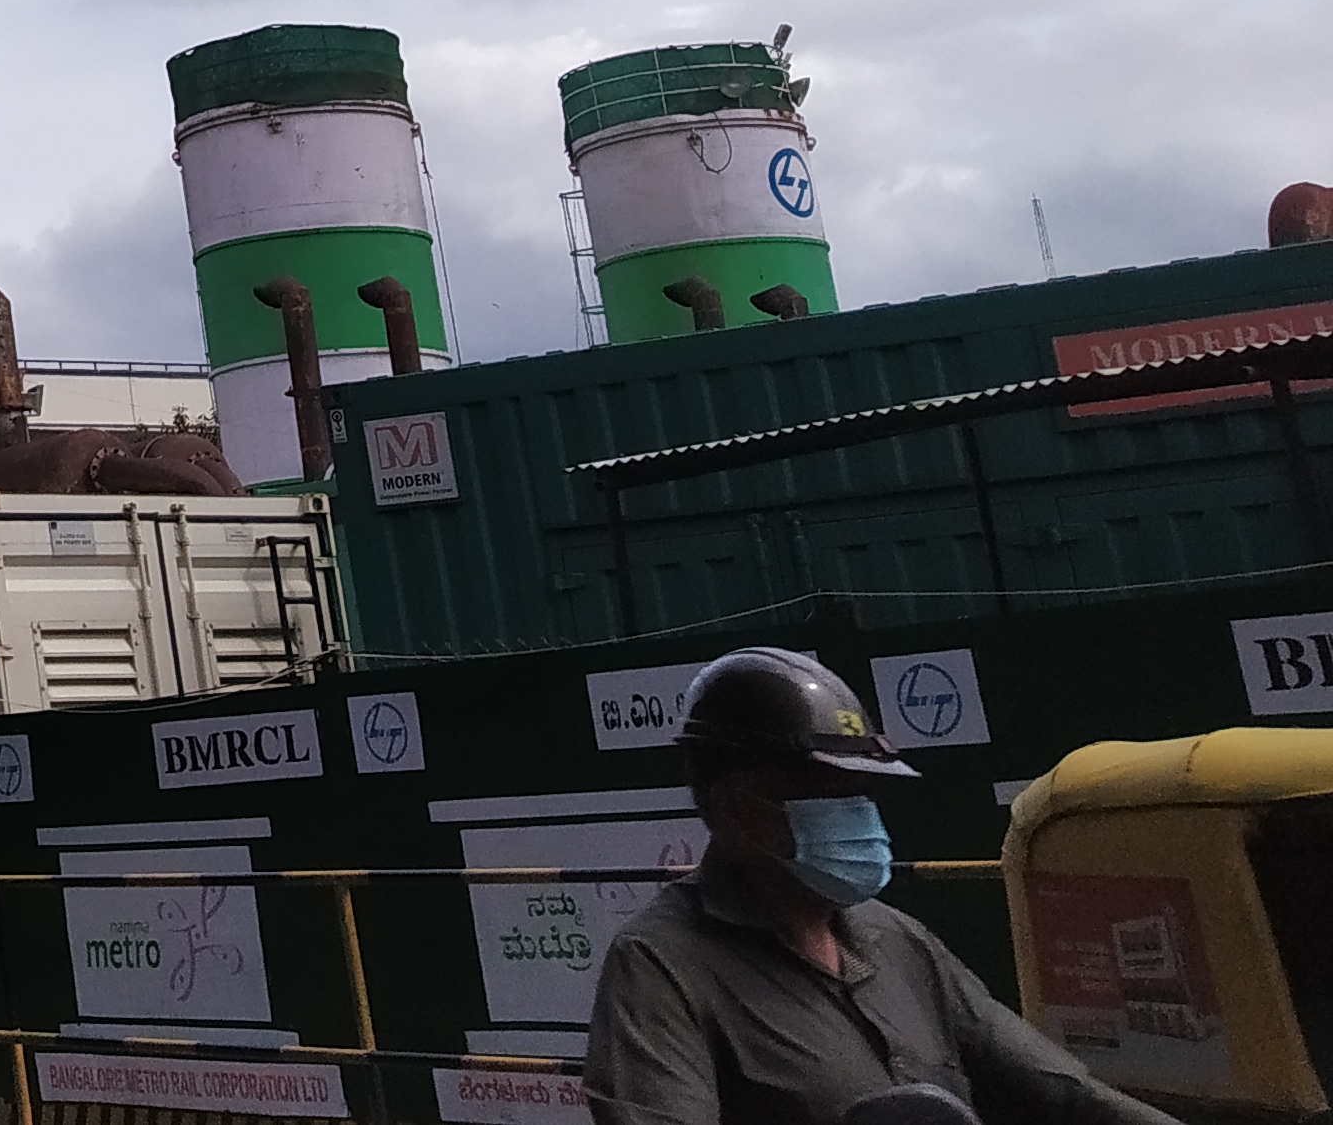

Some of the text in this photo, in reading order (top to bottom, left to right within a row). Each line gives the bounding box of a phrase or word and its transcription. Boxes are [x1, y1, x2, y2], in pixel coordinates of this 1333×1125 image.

[382, 472, 441, 490] MODERN
[162, 724, 310, 774] BMRCL
[526, 892, 585, 927] ನಮ್ಮ
[86, 936, 161, 968] metro
[50, 1064, 329, 1103] BANGALORE METRO RAIL CORPORATION LTD
